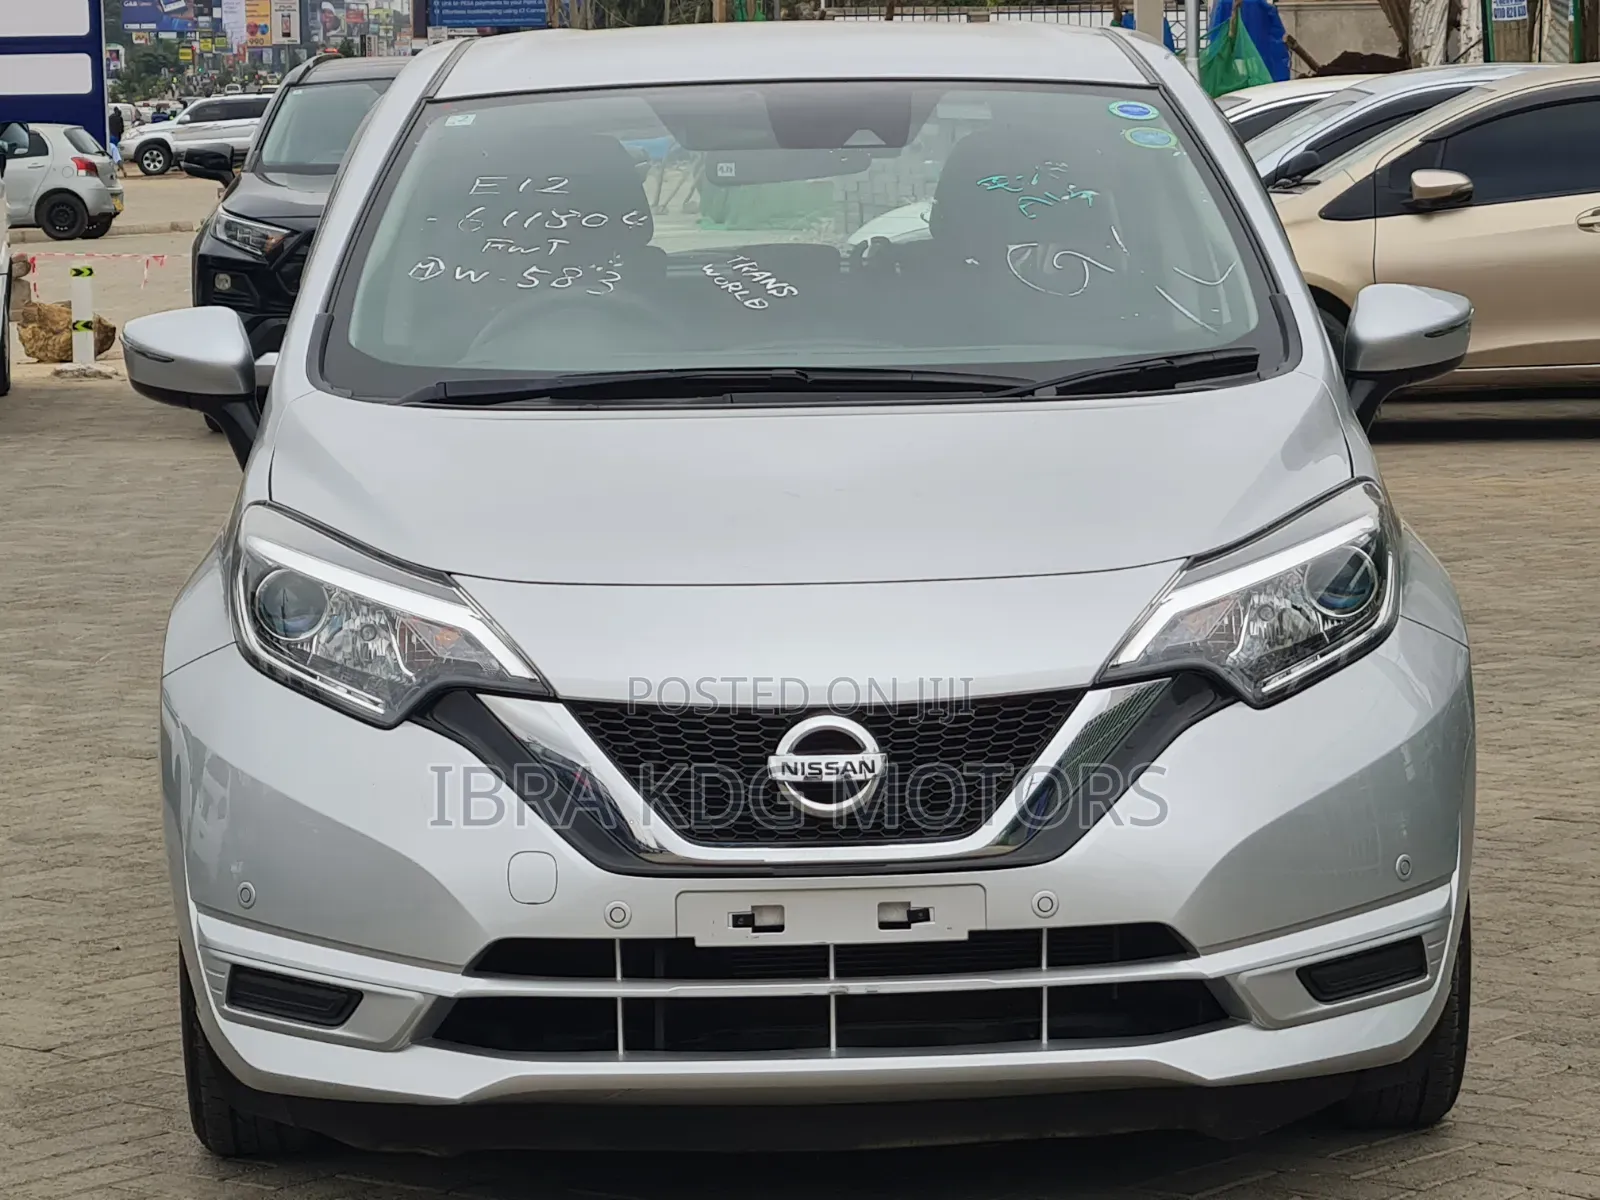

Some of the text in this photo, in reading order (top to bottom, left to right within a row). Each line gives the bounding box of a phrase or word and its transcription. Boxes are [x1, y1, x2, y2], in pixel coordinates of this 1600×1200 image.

[469, 176, 570, 195] E12
[702, 263, 769, 309] WORLD
[727, 254, 799, 297] TRANS
[781, 759, 877, 776] NISSAN
